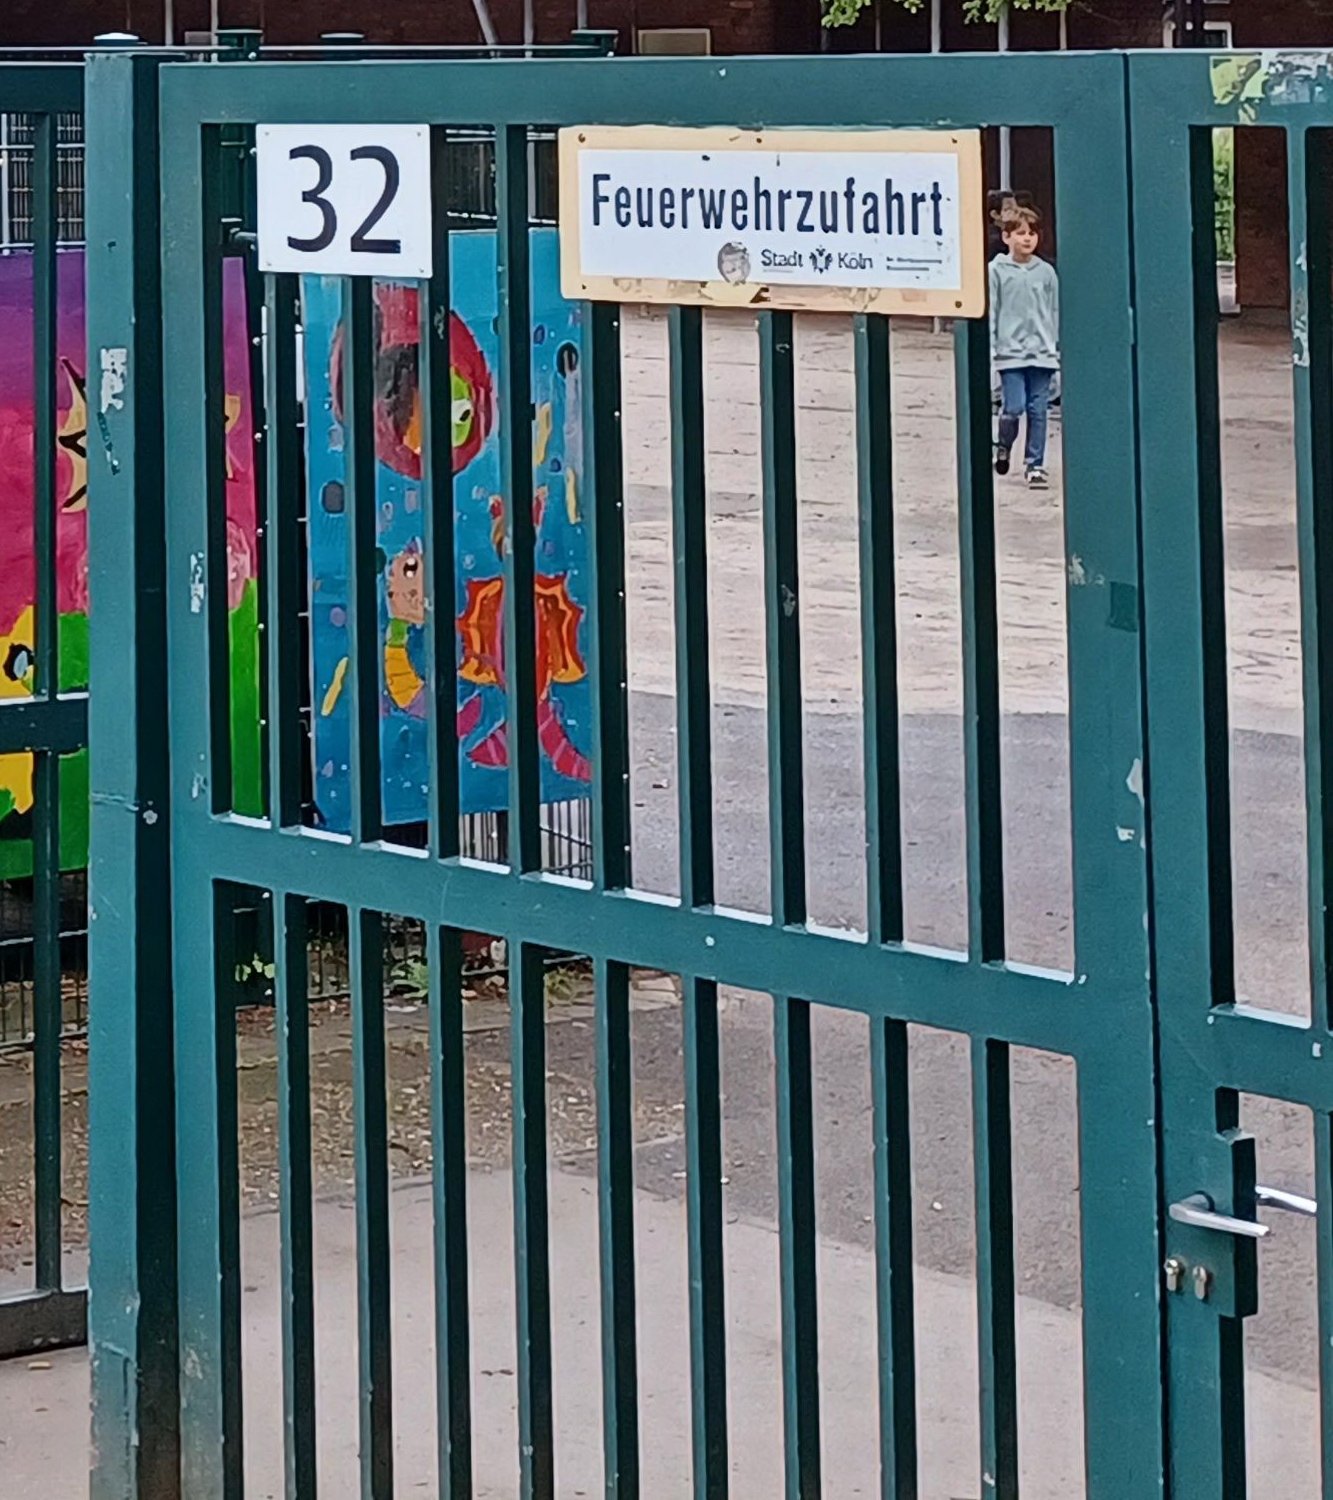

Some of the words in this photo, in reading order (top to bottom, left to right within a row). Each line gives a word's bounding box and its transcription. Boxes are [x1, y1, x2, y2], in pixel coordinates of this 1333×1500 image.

[286, 143, 403, 254] 32
[591, 173, 944, 236] Feuerwehrzufahrt
[760, 248, 804, 268] Stadt
[838, 249, 874, 270] Köln
